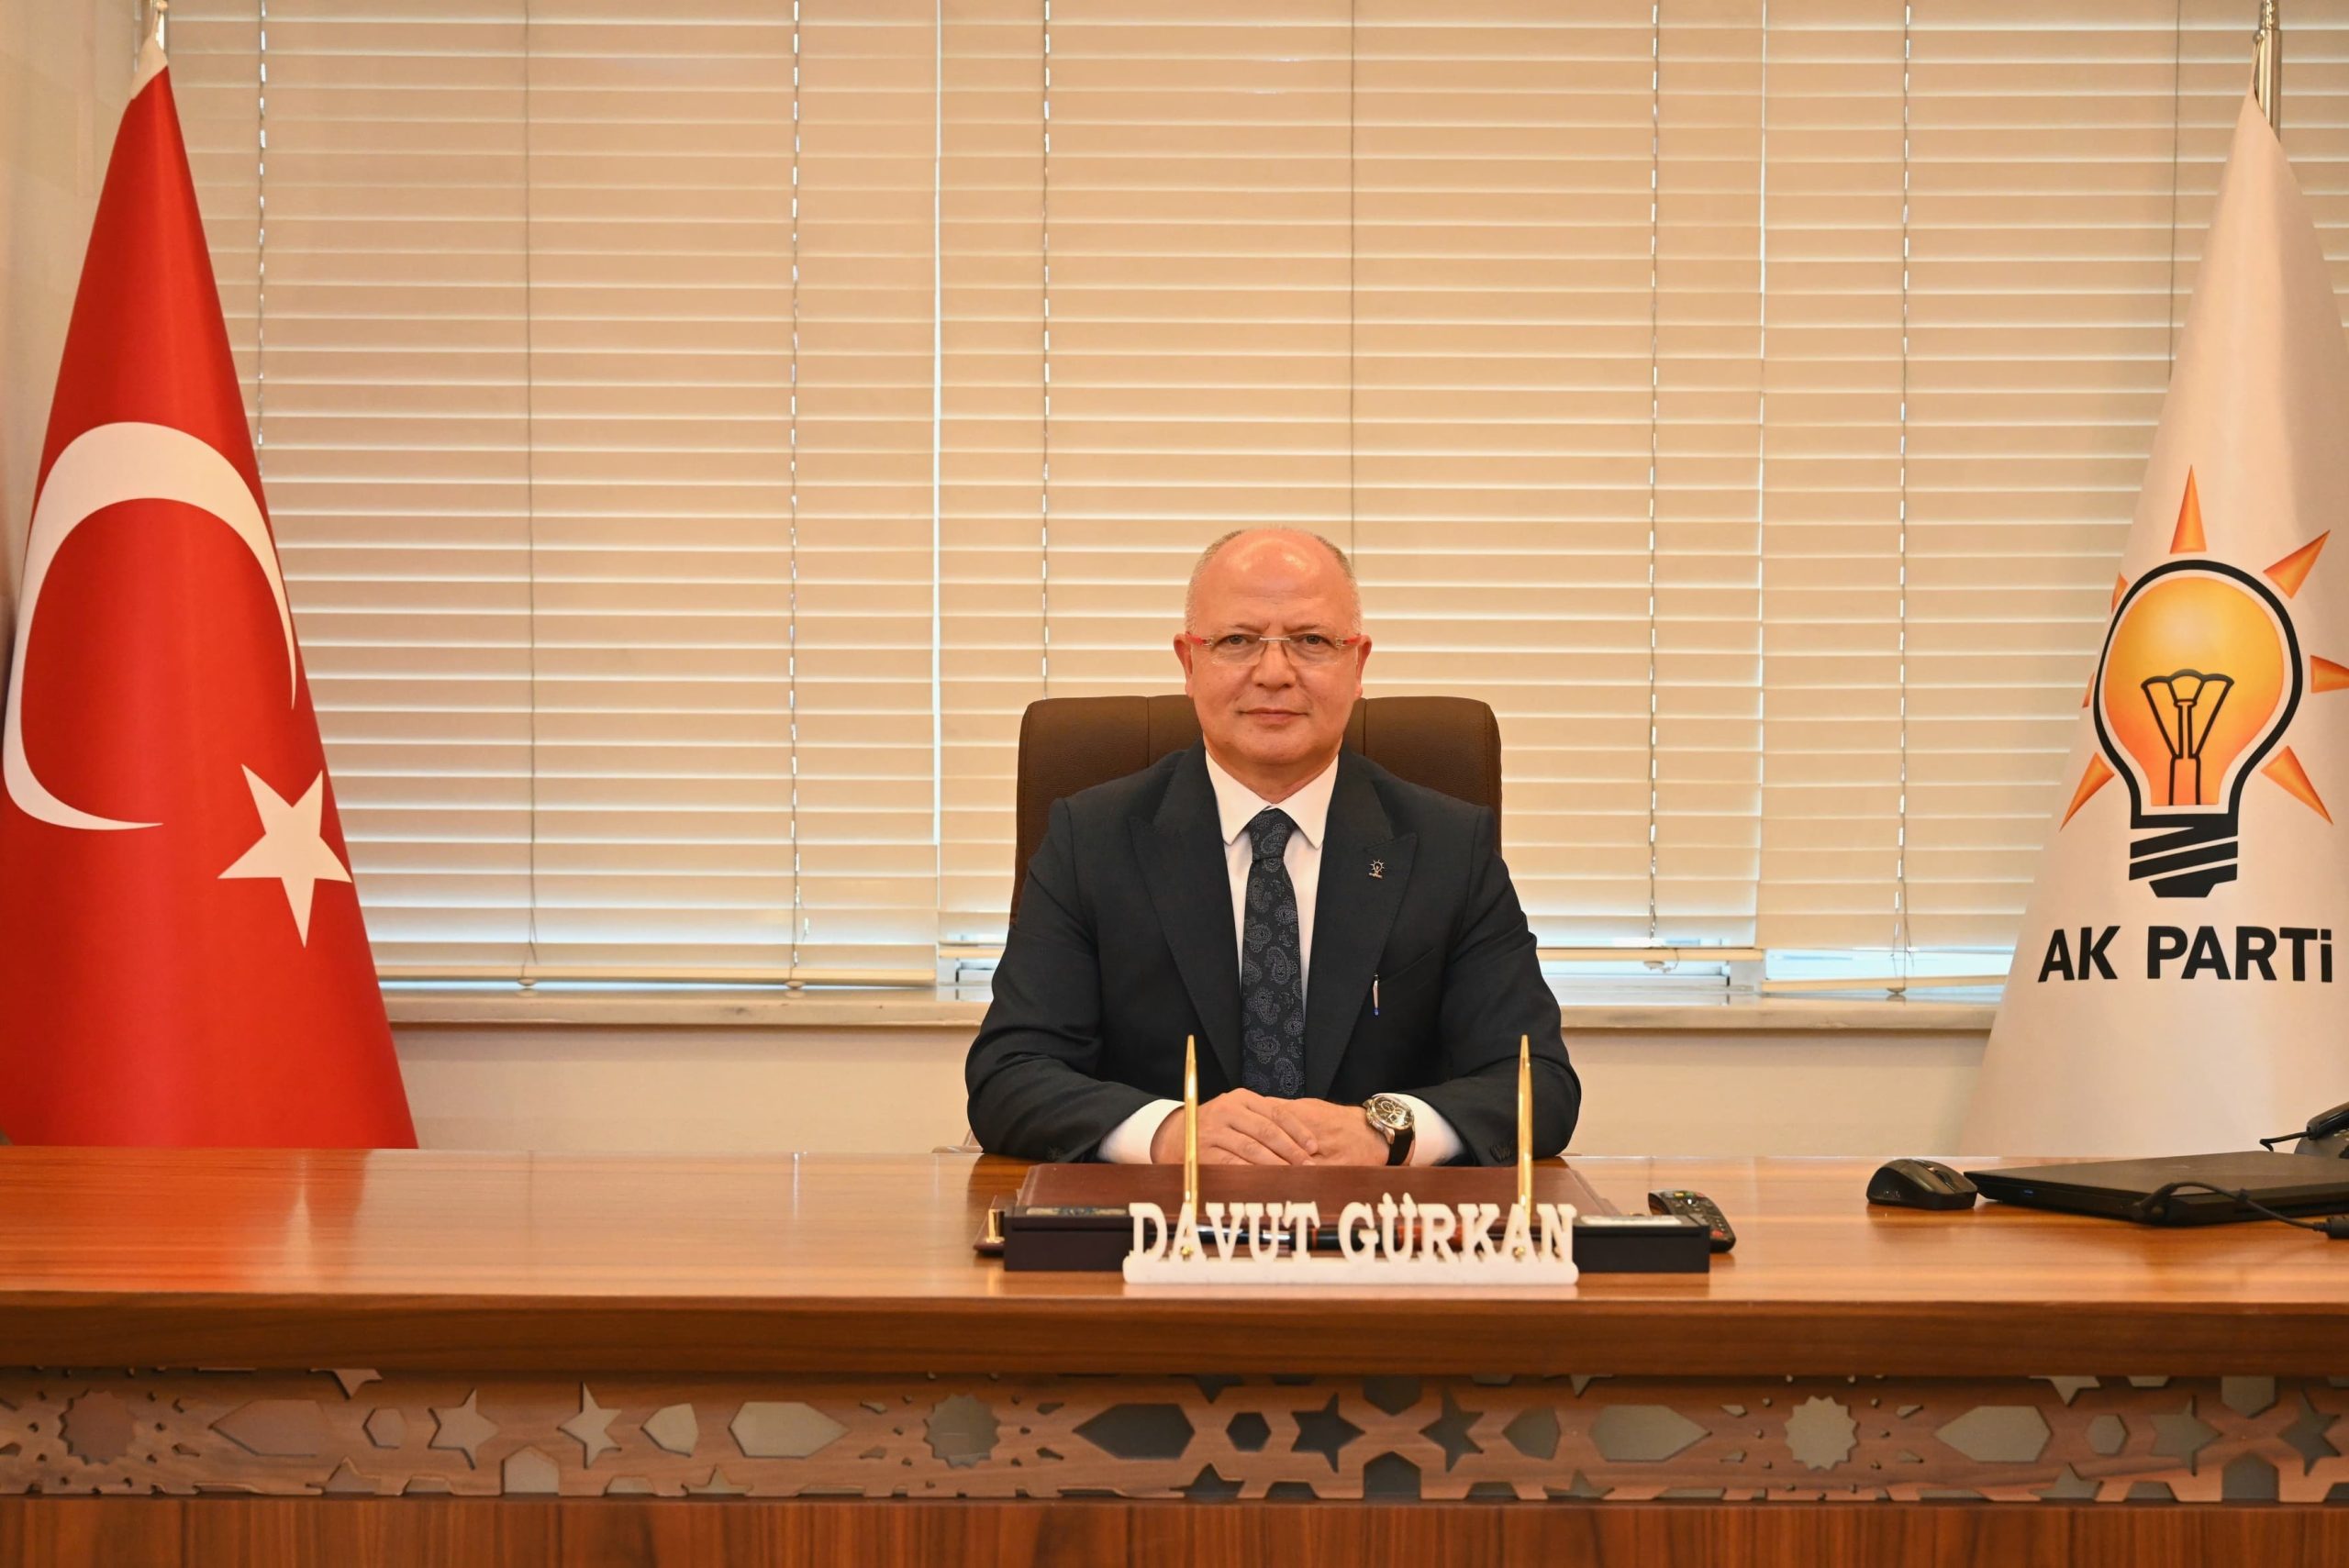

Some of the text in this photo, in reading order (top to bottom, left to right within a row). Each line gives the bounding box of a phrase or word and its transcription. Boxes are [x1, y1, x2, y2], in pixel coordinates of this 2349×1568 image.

[2038, 926, 2121, 983] AK
[1129, 1193, 1577, 1262] DAVUT GÜRKAN
